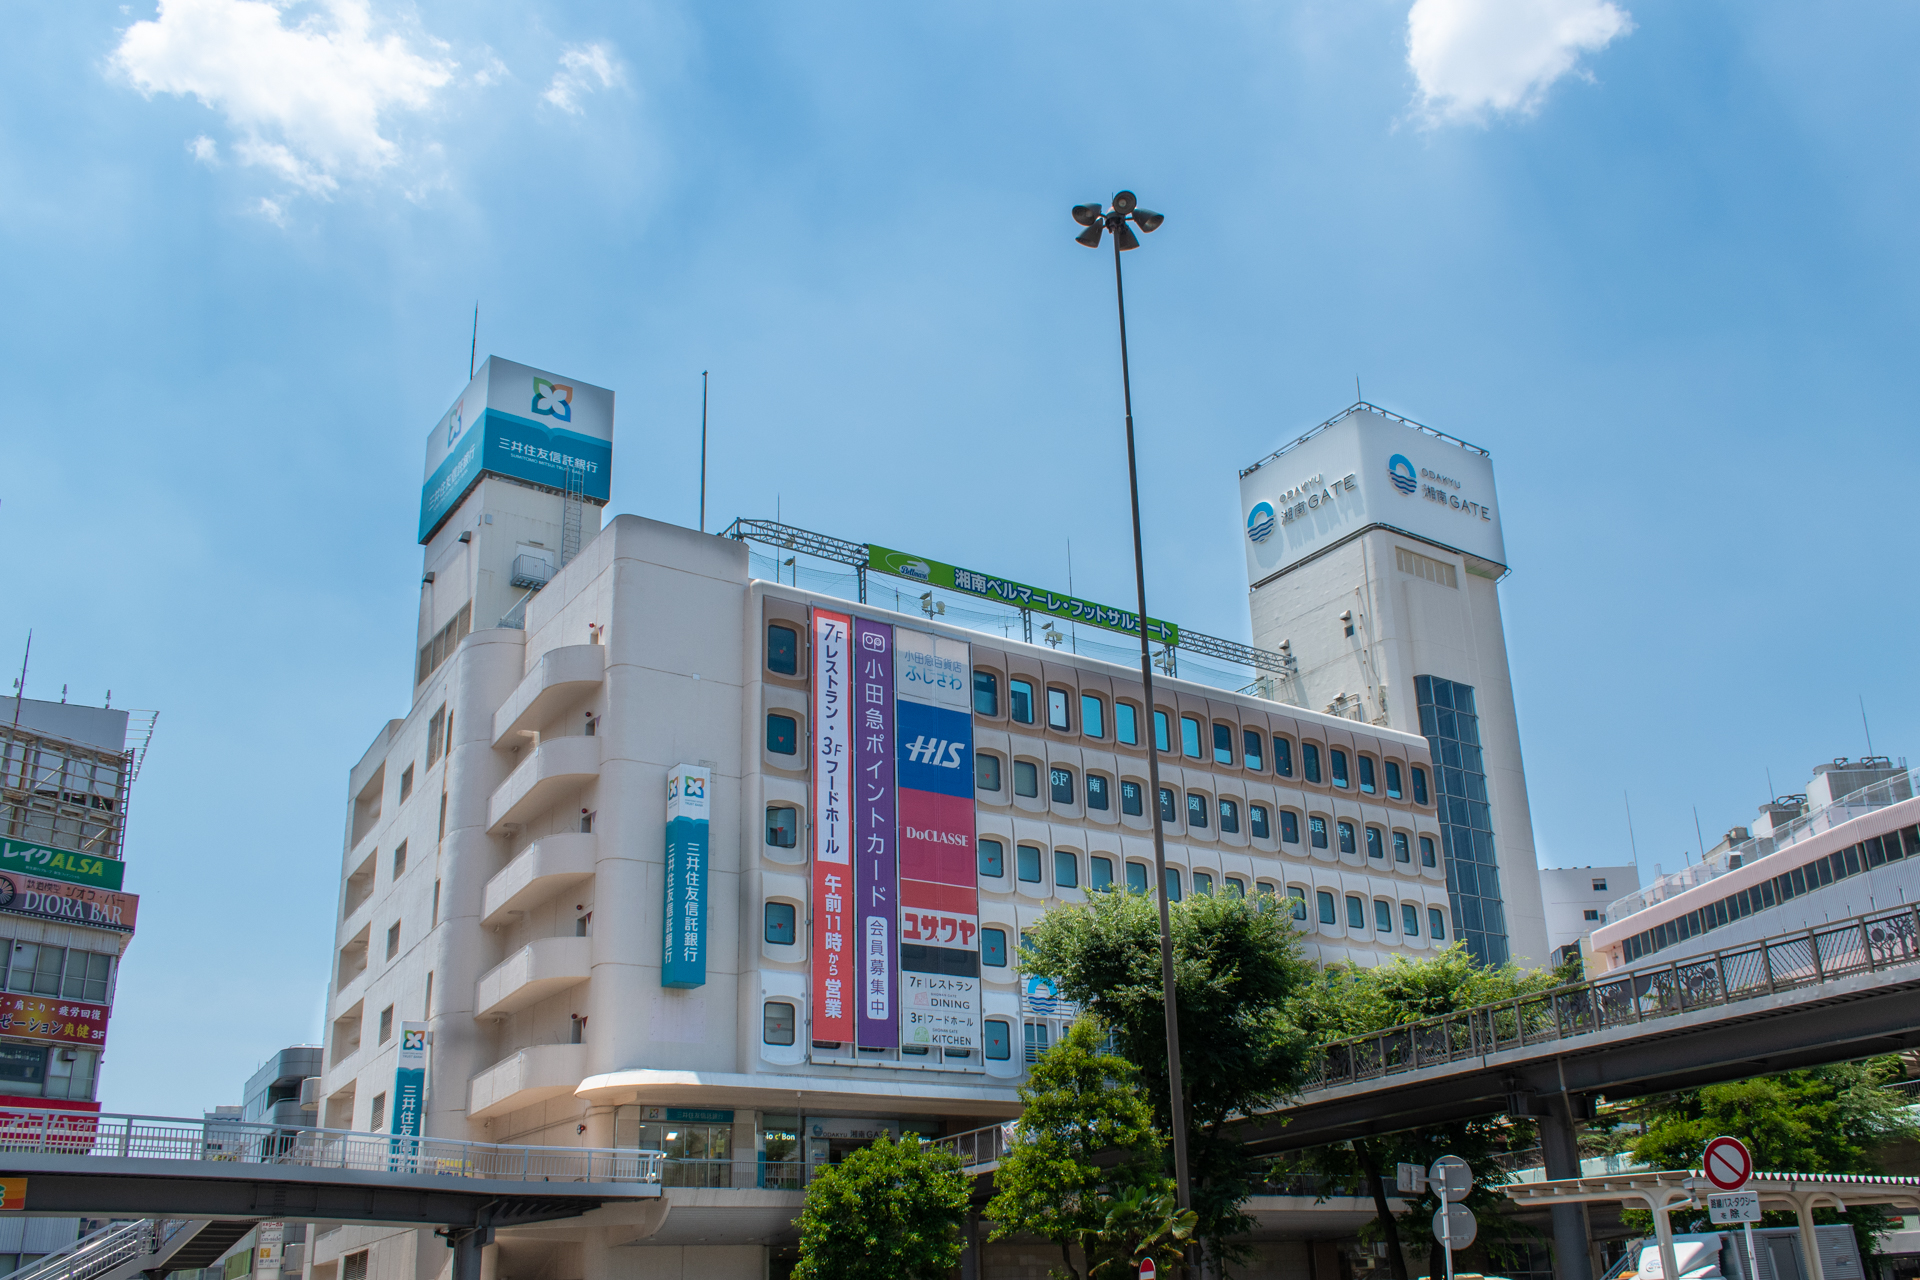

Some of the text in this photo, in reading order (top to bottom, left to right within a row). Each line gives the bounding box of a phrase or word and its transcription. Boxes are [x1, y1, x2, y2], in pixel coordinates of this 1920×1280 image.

[499, 437, 598, 473] 三井住友信託銀行
[1279, 473, 1323, 503] ODAKYU
[1421, 467, 1461, 490] ODAKYU
[904, 650, 962, 673] 小田急百貨店
[905, 665, 963, 690] ふじさわ
[865, 659, 886, 907] 小田急ポイントカード
[1051, 771, 1068, 786] 6F
[906, 826, 969, 848] DoCLASSE
[23, 890, 122, 925] DIORA BAR
[665, 843, 675, 964] 三井住友信託銀行
[684, 843, 700, 962] 三井住友信託銀行
[903, 913, 976, 945] ユザワヤ
[825, 873, 842, 1019] 午前11時から営業
[870, 919, 885, 1015] 会員募集中
[910, 976, 973, 991] 7F レストラン
[931, 998, 970, 1009] DINING
[910, 1011, 973, 1026] 3F フードホール
[91, 1030, 105, 1039] 3F
[932, 1034, 971, 1045] KITCHEN
[782, 1132, 795, 1140] Bon
